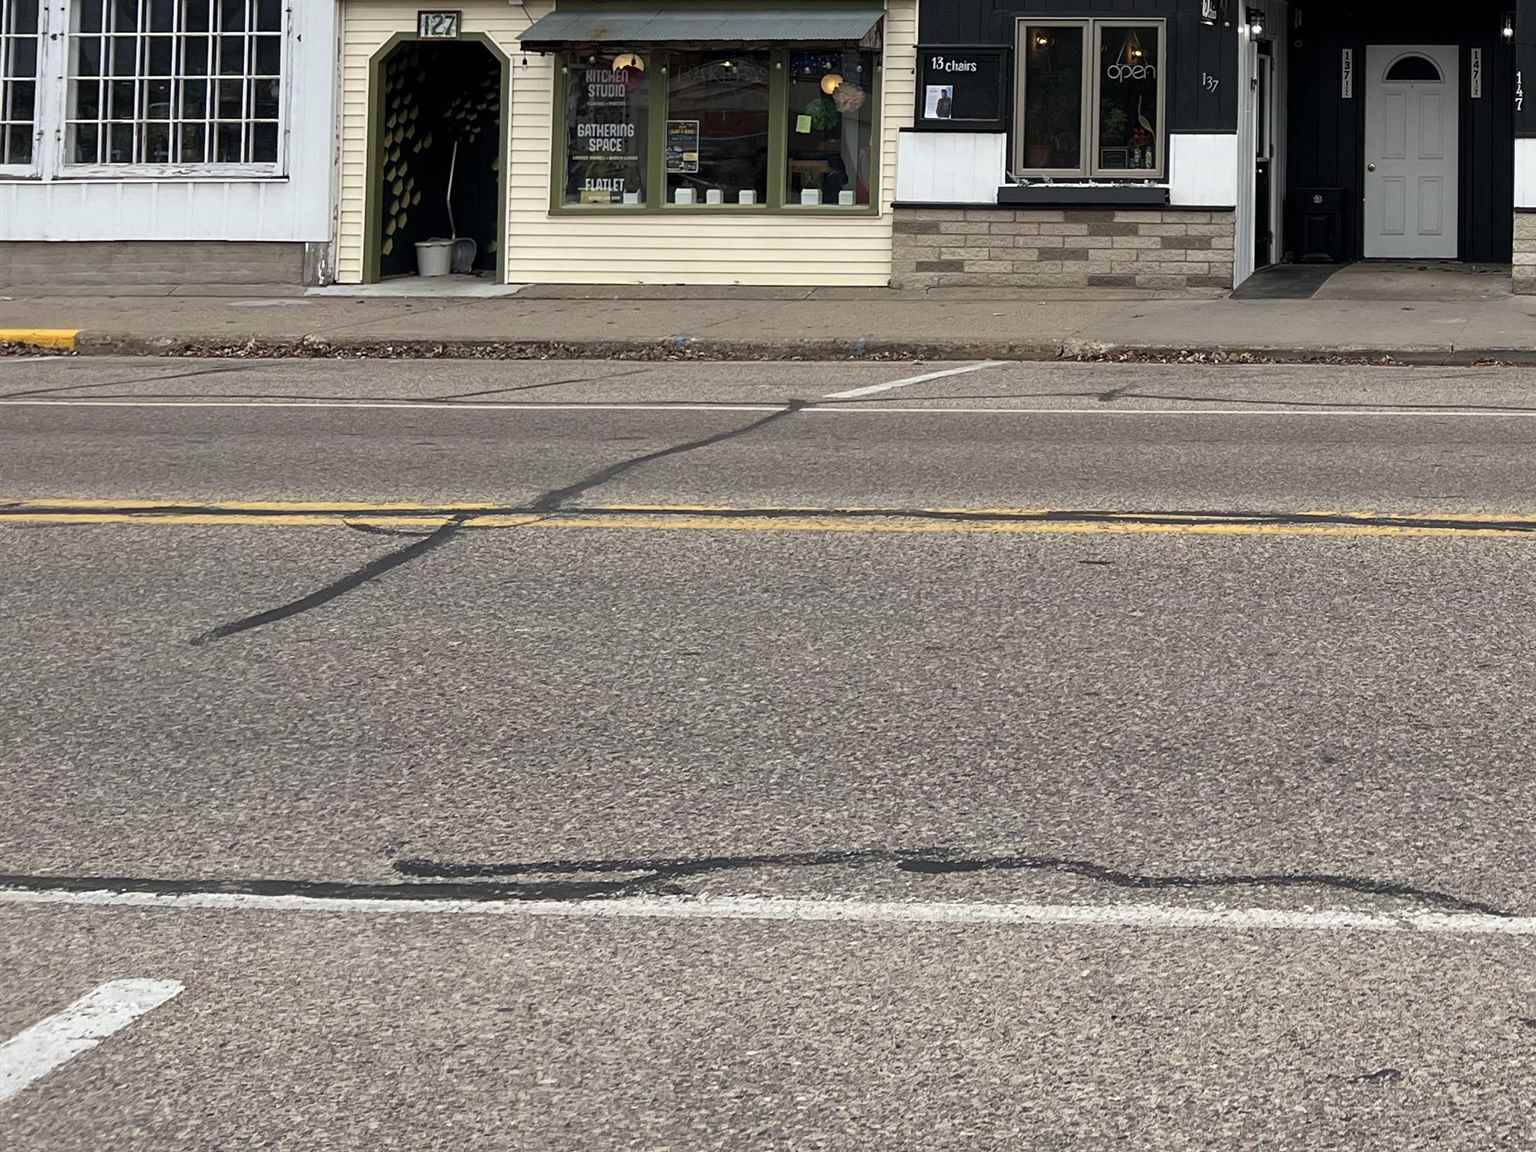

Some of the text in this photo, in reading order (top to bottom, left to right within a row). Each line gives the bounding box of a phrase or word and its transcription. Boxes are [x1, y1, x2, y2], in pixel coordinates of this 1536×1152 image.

[424, 14, 456, 36] 127
[931, 56, 978, 73] 13 chairs
[585, 69, 629, 83] KITCHEN
[1107, 64, 1156, 83] open
[1202, 72, 1220, 93] 137
[587, 84, 626, 98] STUDIO
[1514, 70, 1524, 112] 147
[577, 123, 635, 138] GATHERING
[588, 138, 622, 152] SPACE
[585, 177, 625, 192] FLATLET
